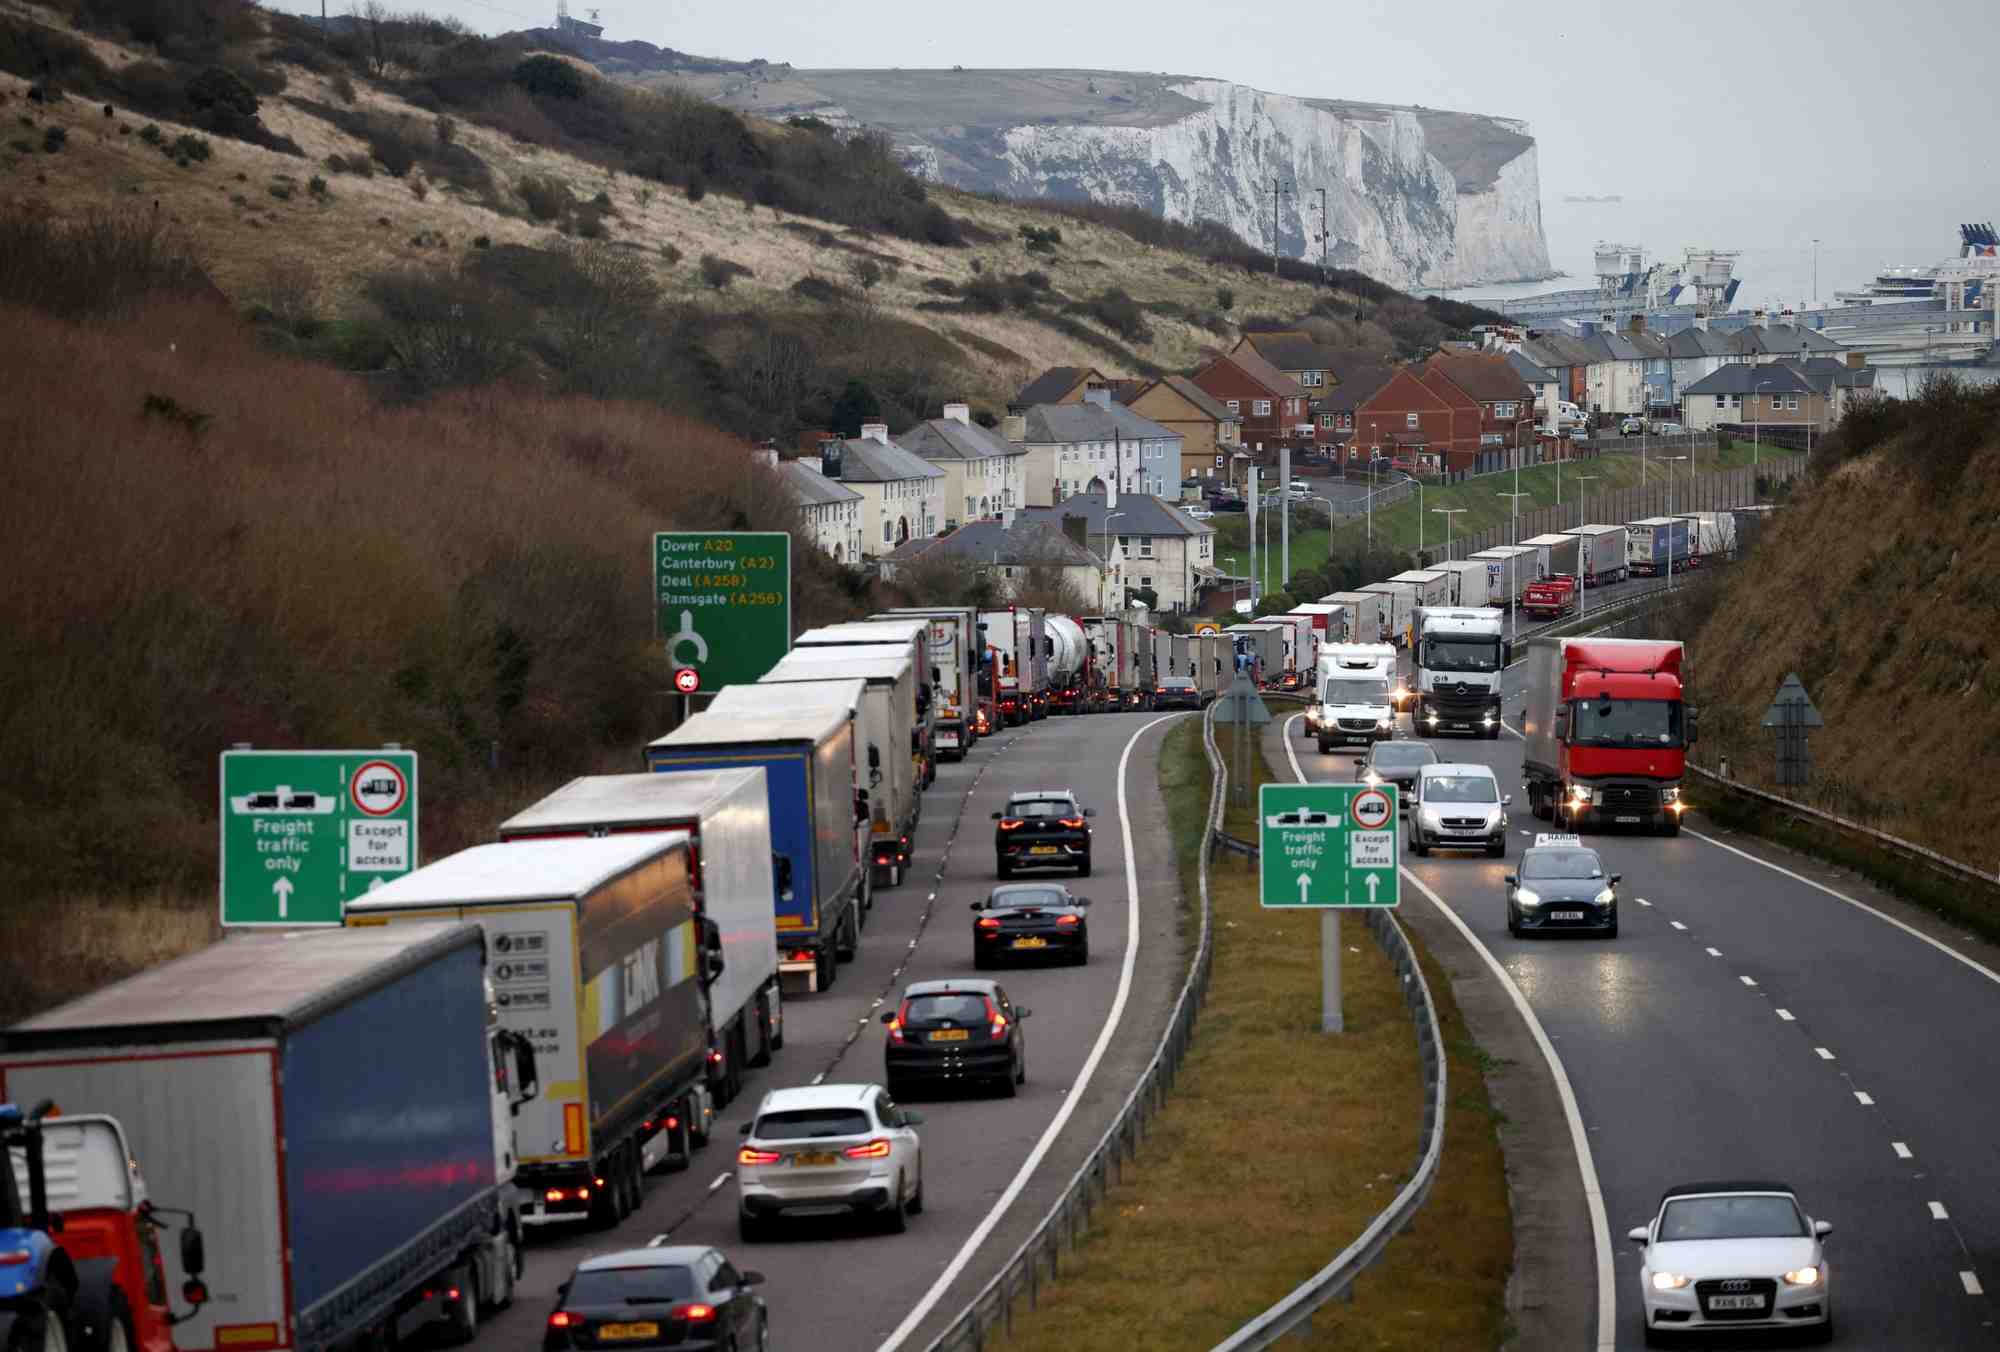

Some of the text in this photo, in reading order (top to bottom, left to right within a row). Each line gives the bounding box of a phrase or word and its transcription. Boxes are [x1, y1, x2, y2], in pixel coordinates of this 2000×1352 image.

[661, 539, 700, 551] Dover
[661, 556, 775, 570] Canterbury (A2)
[661, 575, 692, 587] Deal
[661, 593, 727, 606] Ramsgate
[252, 818, 315, 836] Freight
[354, 824, 403, 839] Except
[1281, 831, 1326, 844] Freight
[1355, 834, 1390, 845] Except
[256, 837, 310, 852] traffic
[367, 840, 388, 851] for
[1284, 845, 1323, 855] traffic
[1364, 845, 1379, 853] for
[264, 855, 301, 873] only
[355, 855, 402, 865] access
[1290, 858, 1317, 870] only
[1355, 856, 1389, 864] access
